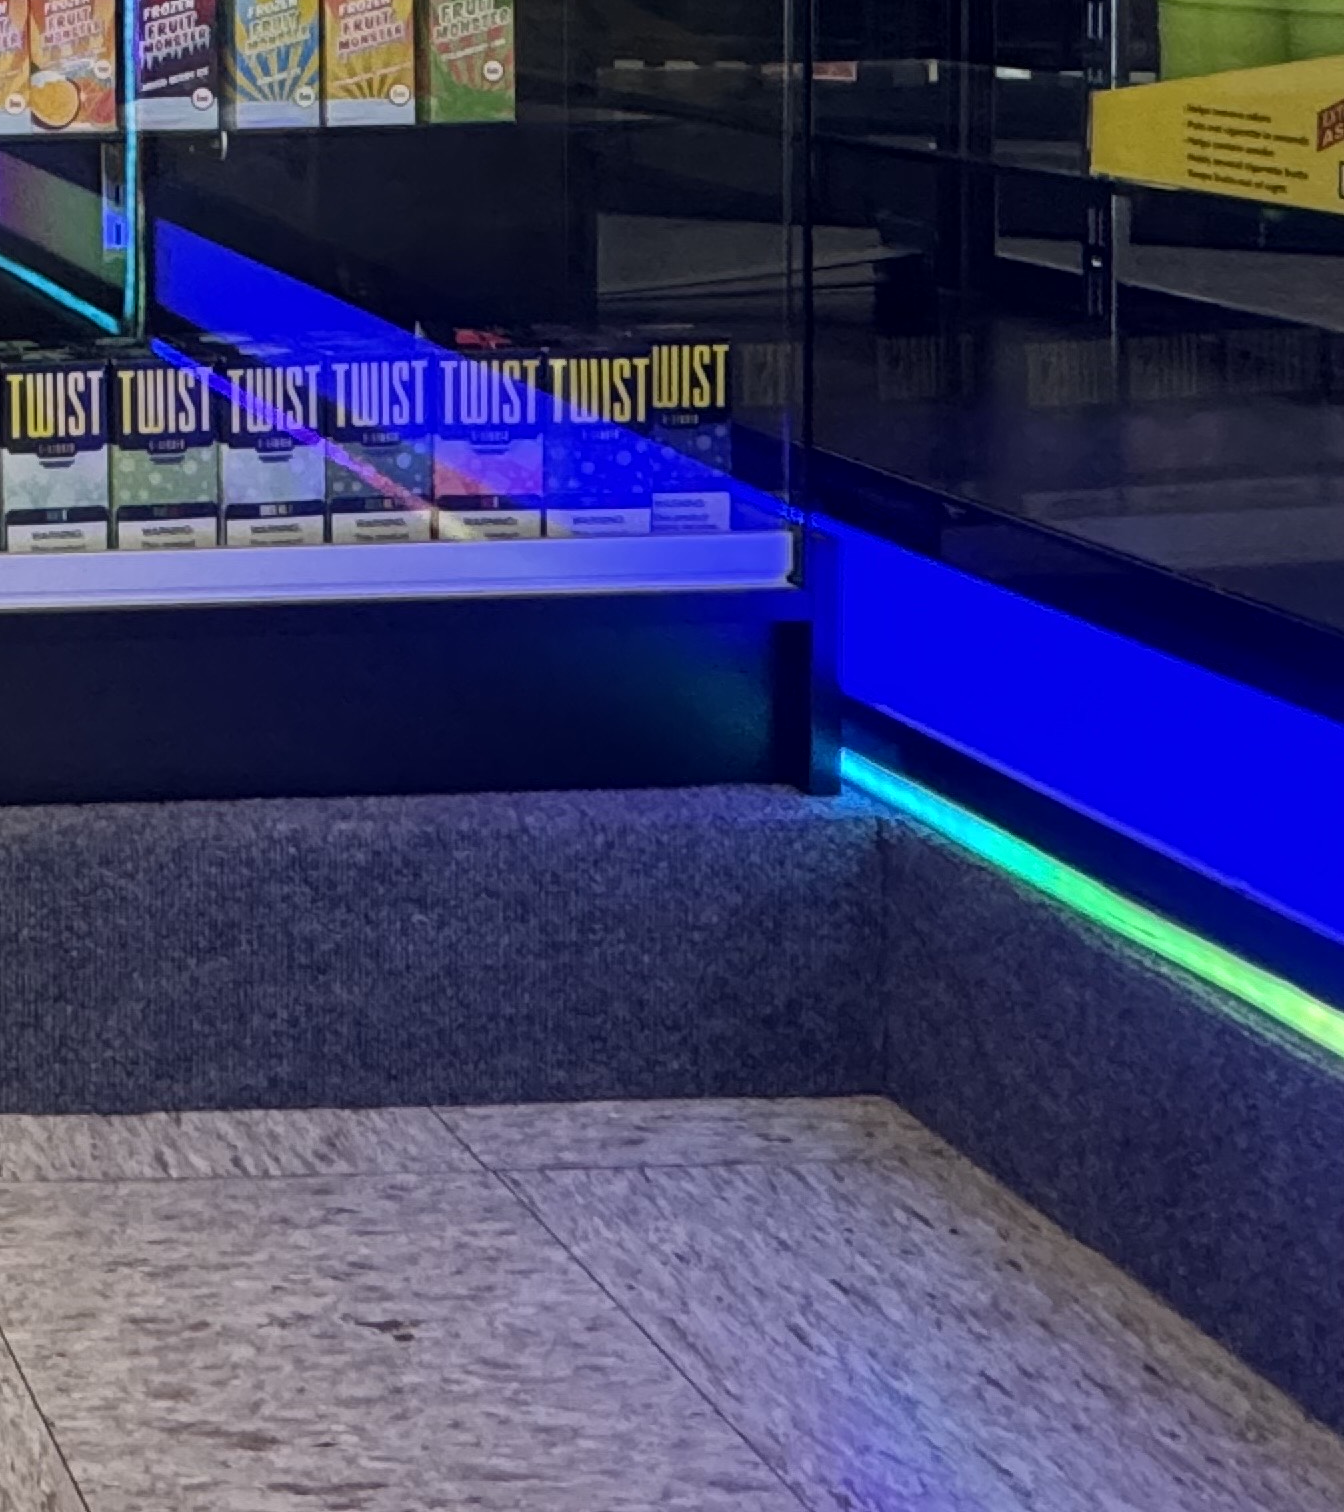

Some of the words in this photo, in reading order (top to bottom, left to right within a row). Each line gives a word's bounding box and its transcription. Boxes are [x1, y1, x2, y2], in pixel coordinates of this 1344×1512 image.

[142, 27, 210, 54] MONSTER
[144, 12, 197, 39] FRUIT
[5, 371, 103, 440] TWIST
[118, 367, 213, 436] TWIST
[226, 365, 321, 434] TWIST
[331, 361, 428, 429] TWIST
[440, 359, 538, 426] TWIST
[548, 358, 650, 424] TWIST
[651, 344, 729, 410] WIST
